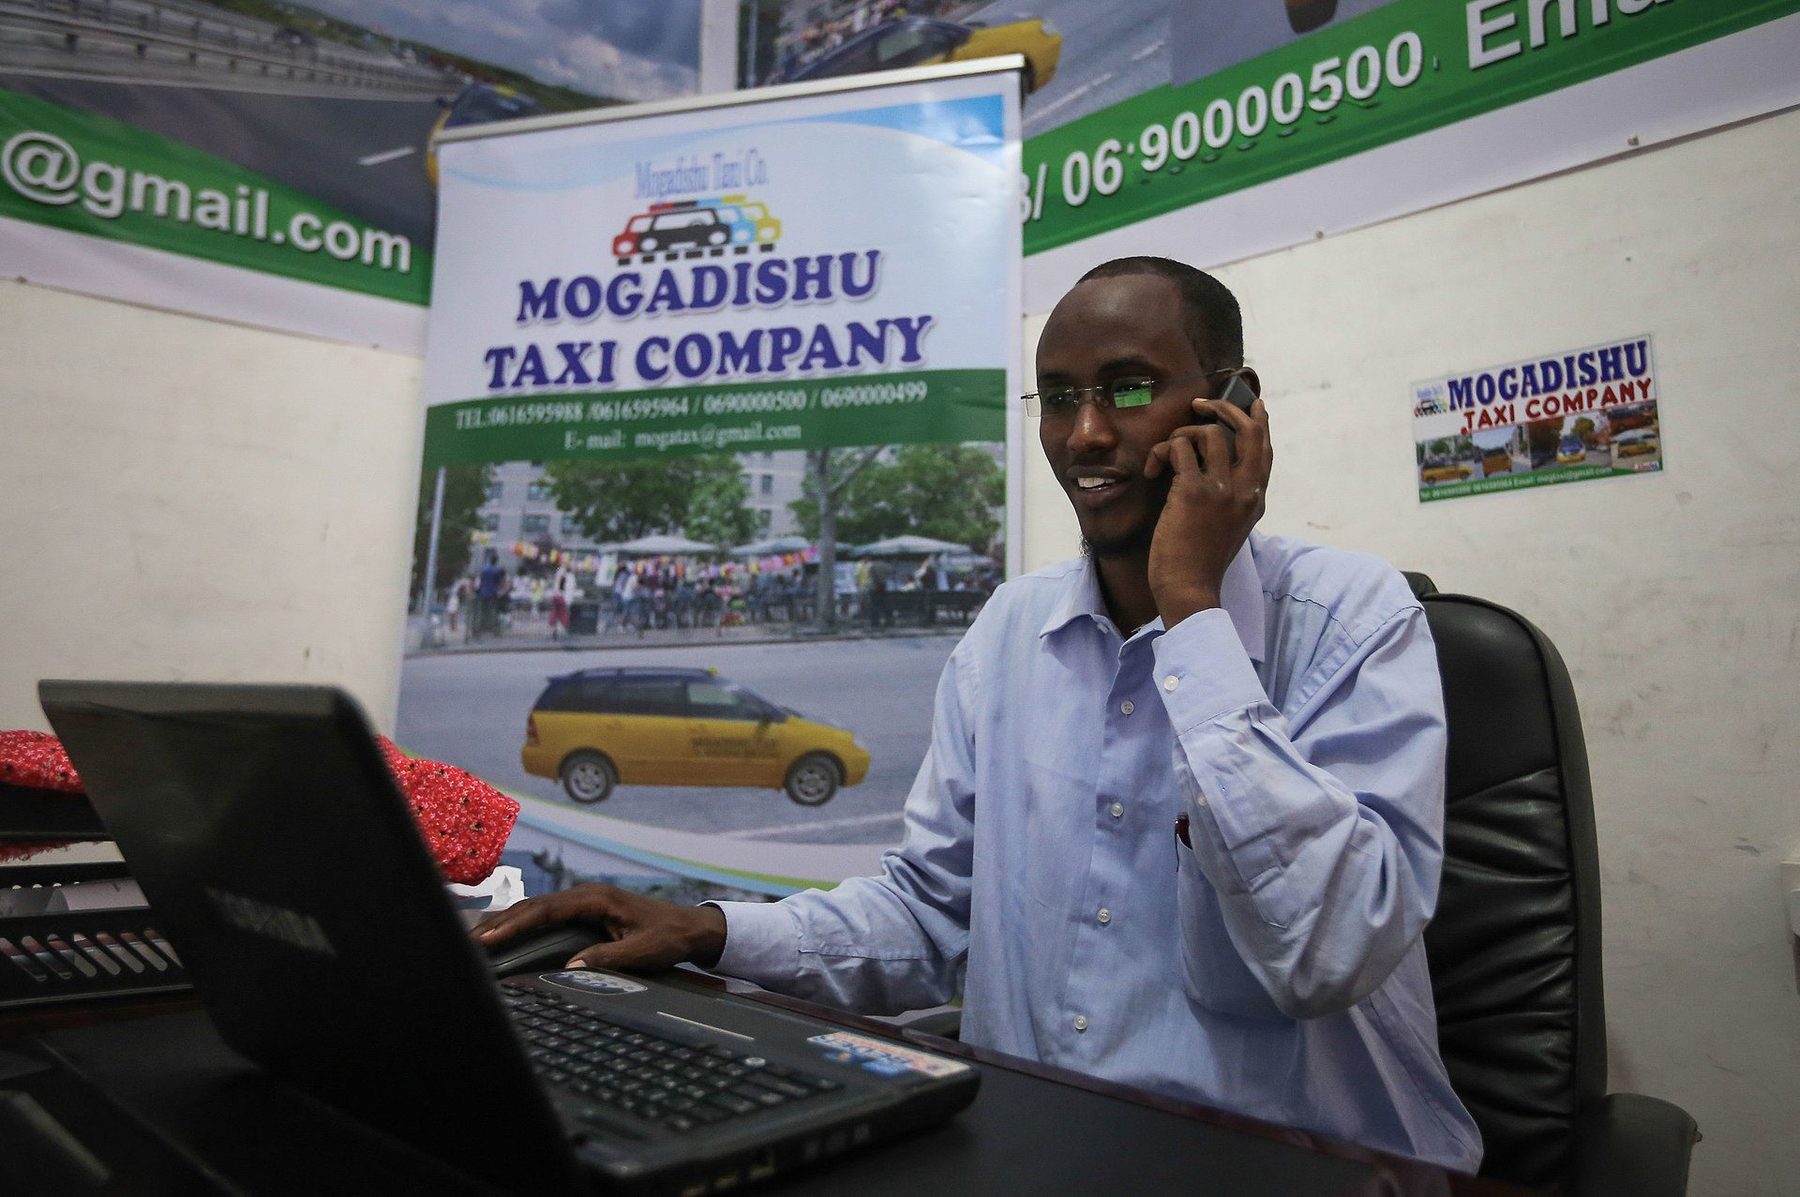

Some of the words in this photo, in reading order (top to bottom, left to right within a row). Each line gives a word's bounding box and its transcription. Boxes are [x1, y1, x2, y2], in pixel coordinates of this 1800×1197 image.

[2, 131, 412, 273] @gmail.com
[633, 154, 709, 199] Mogadishu
[712, 151, 744, 191] Taxi
[515, 249, 881, 323] MOGADISHU
[484, 339, 616, 392] TAXI
[634, 315, 932, 382] COMPANY
[1447, 339, 1648, 412] MOGADISHU
[1463, 402, 1516, 431] TAXI
[1525, 377, 1652, 419] COMPANY
